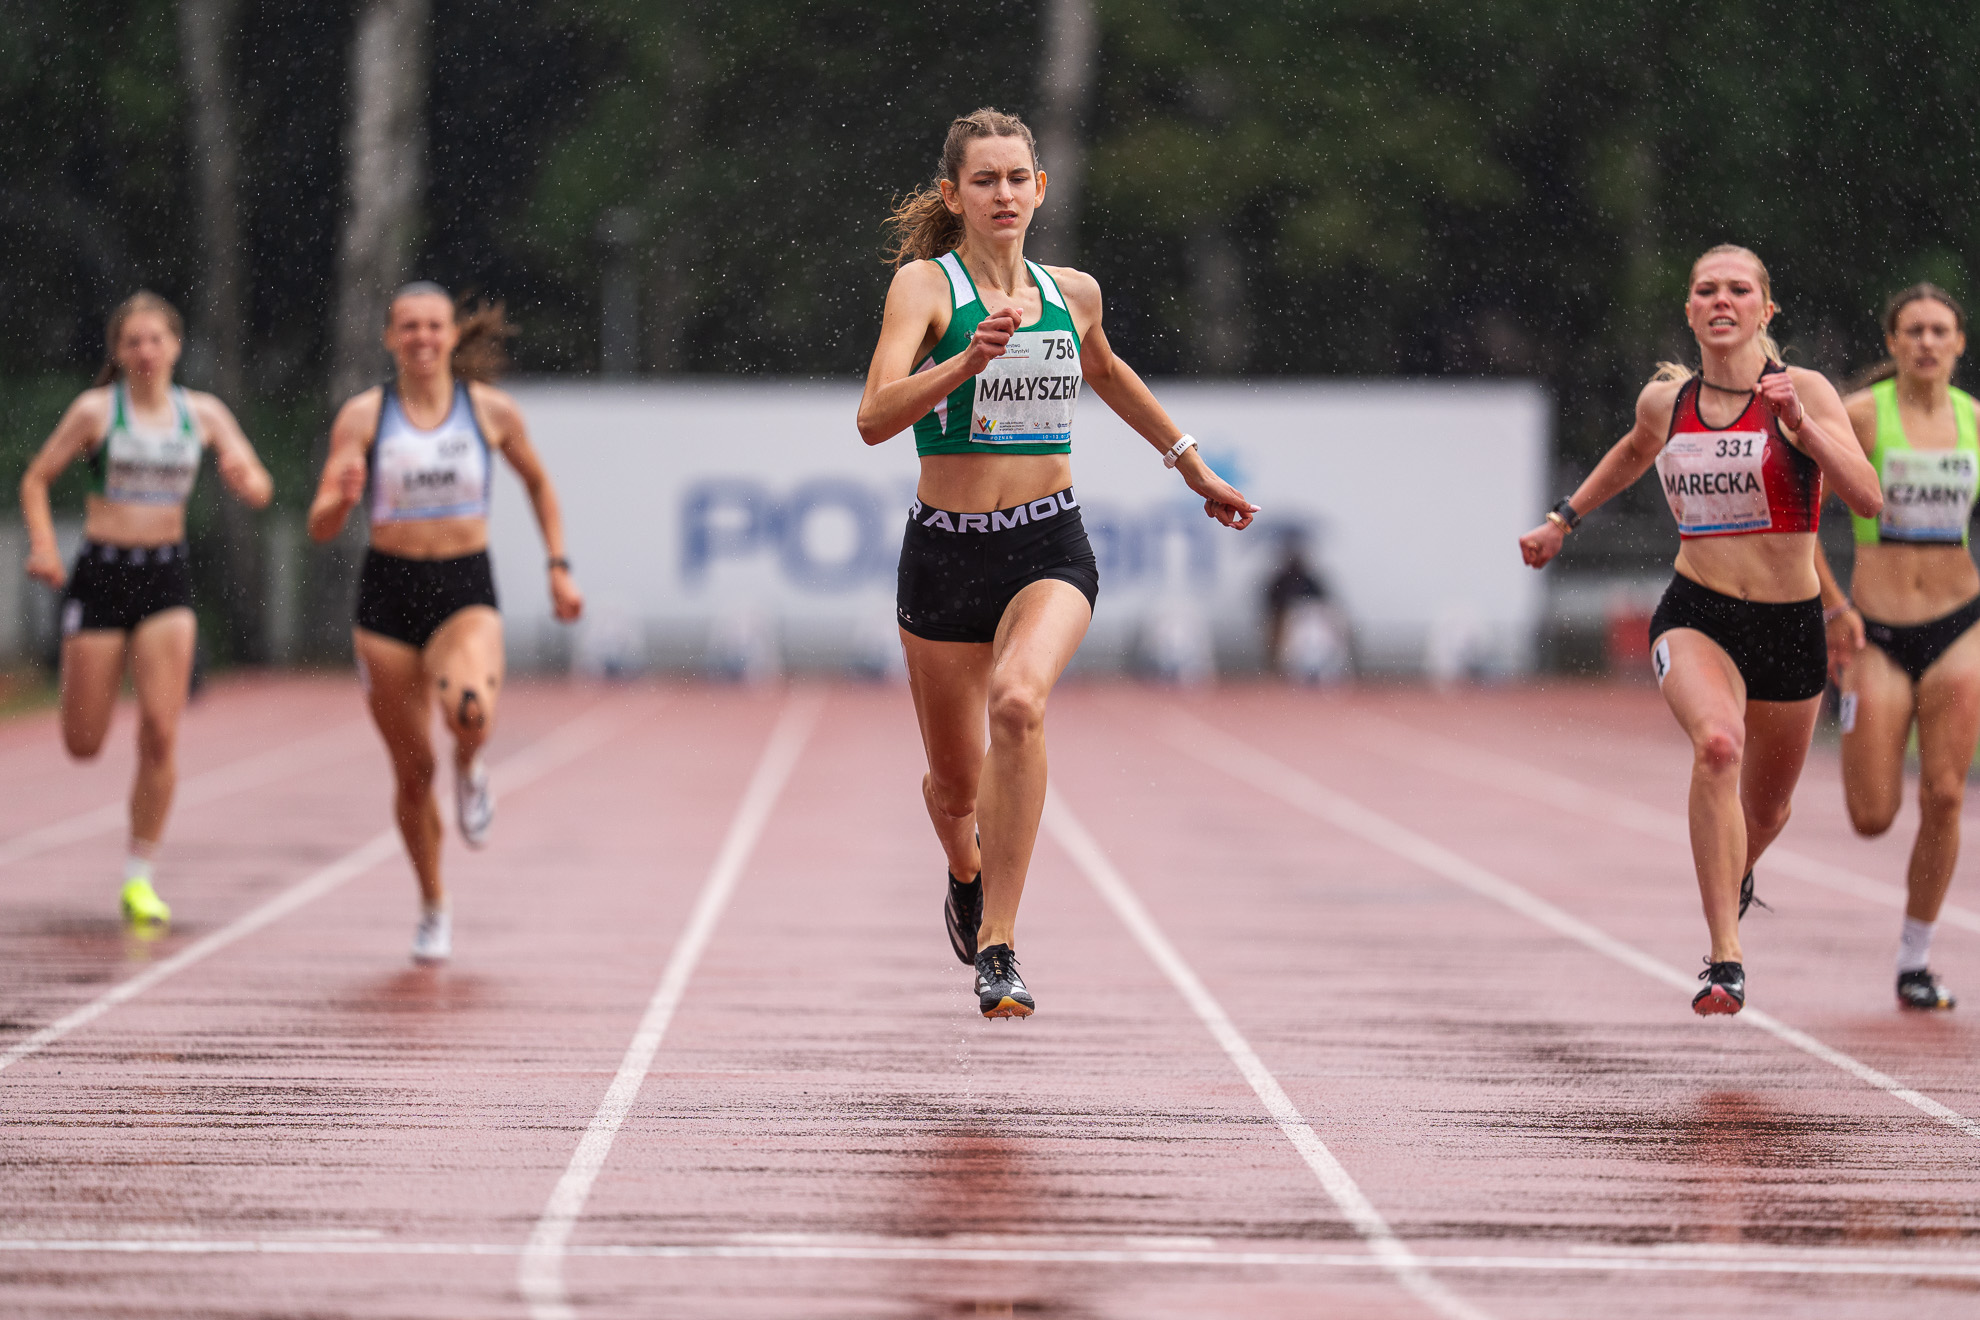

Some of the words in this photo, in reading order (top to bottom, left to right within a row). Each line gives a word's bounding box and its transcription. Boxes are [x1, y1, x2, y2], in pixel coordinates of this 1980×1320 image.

[1042, 338, 1075, 360] 758
[979, 375, 1080, 402] MAŁYSZEK
[1715, 439, 1753, 458] 331
[1664, 472, 1760, 496] MARECKA
[922, 487, 1079, 533] ARMOU
